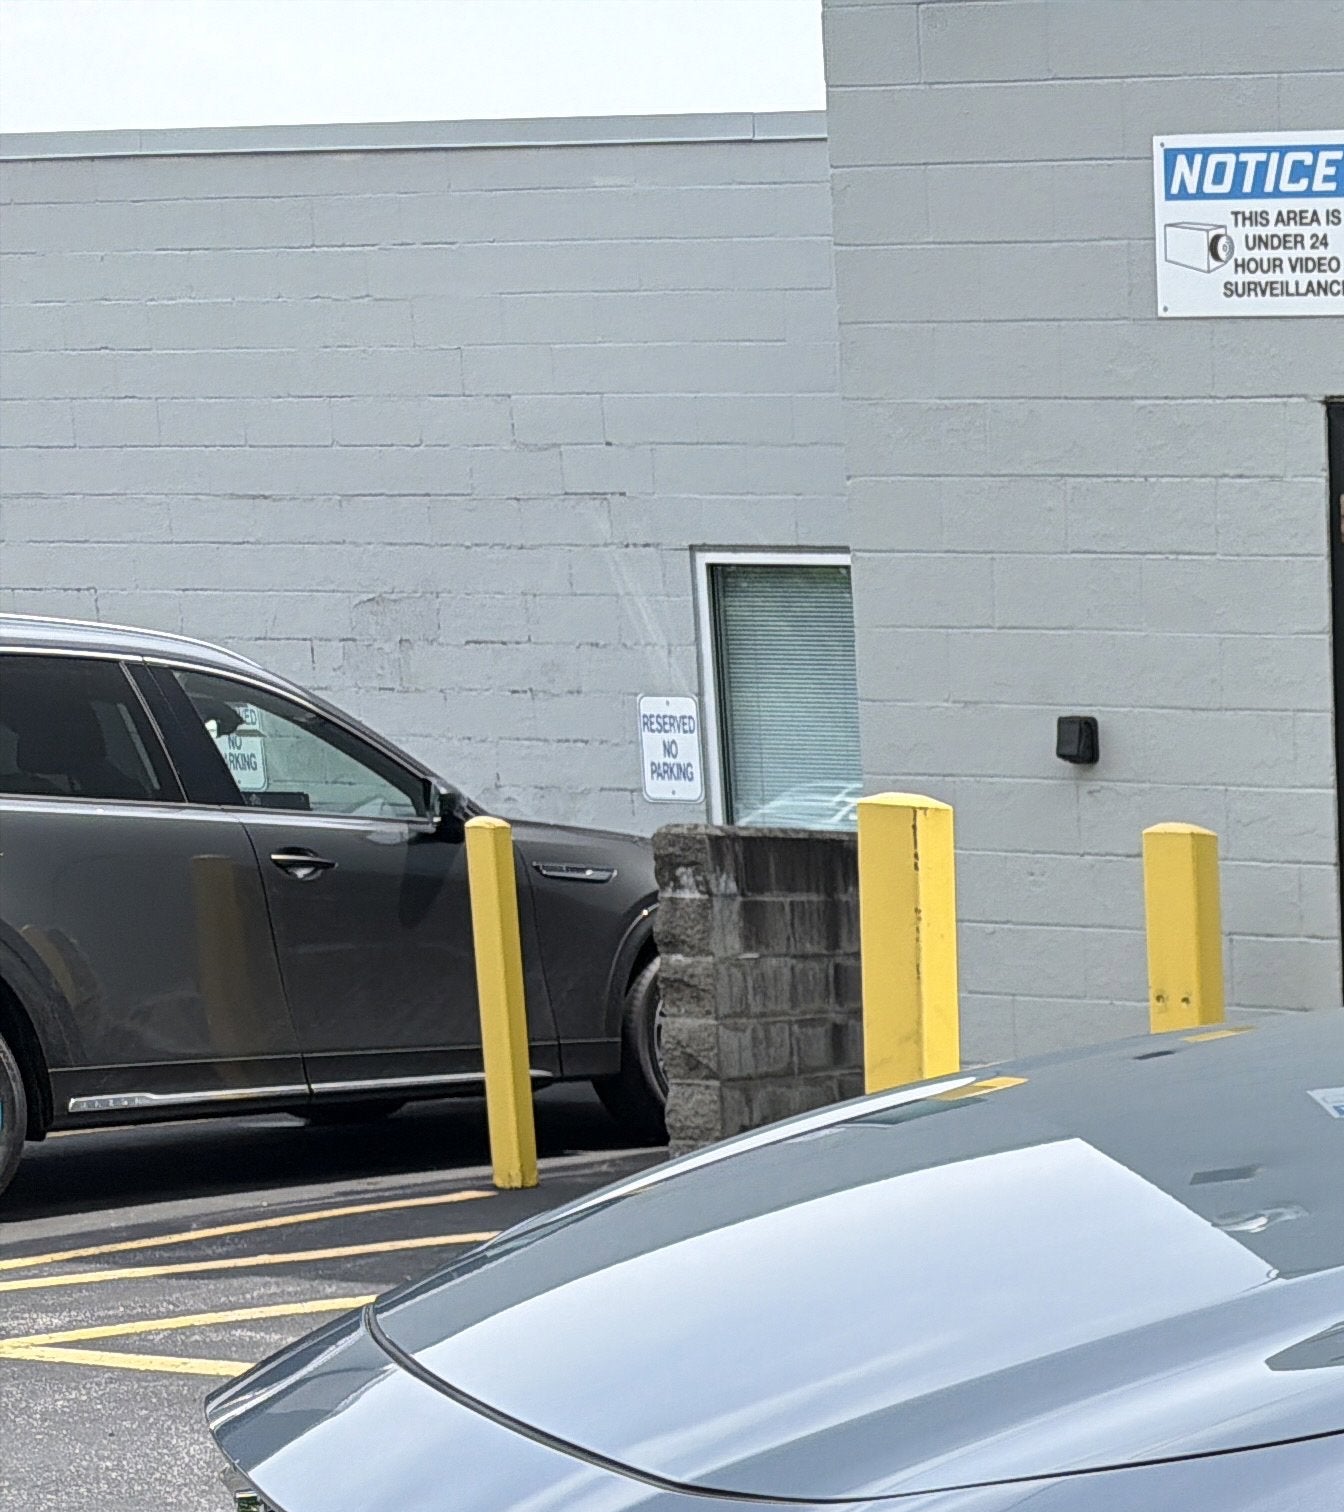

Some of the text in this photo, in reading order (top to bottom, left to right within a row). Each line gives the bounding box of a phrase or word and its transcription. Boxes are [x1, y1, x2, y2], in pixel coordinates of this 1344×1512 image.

[1170, 150, 1344, 195] NOTICE
[1231, 208, 1342, 228] THIS AREA IS
[1244, 233, 1328, 251] UNDER 24
[1234, 256, 1341, 274] HOUR VIDEO
[642, 713, 696, 734] RESERVED
[228, 736, 243, 750] NO
[662, 739, 679, 759] NO
[227, 753, 258, 771] RKING
[650, 761, 694, 782] PARKING
